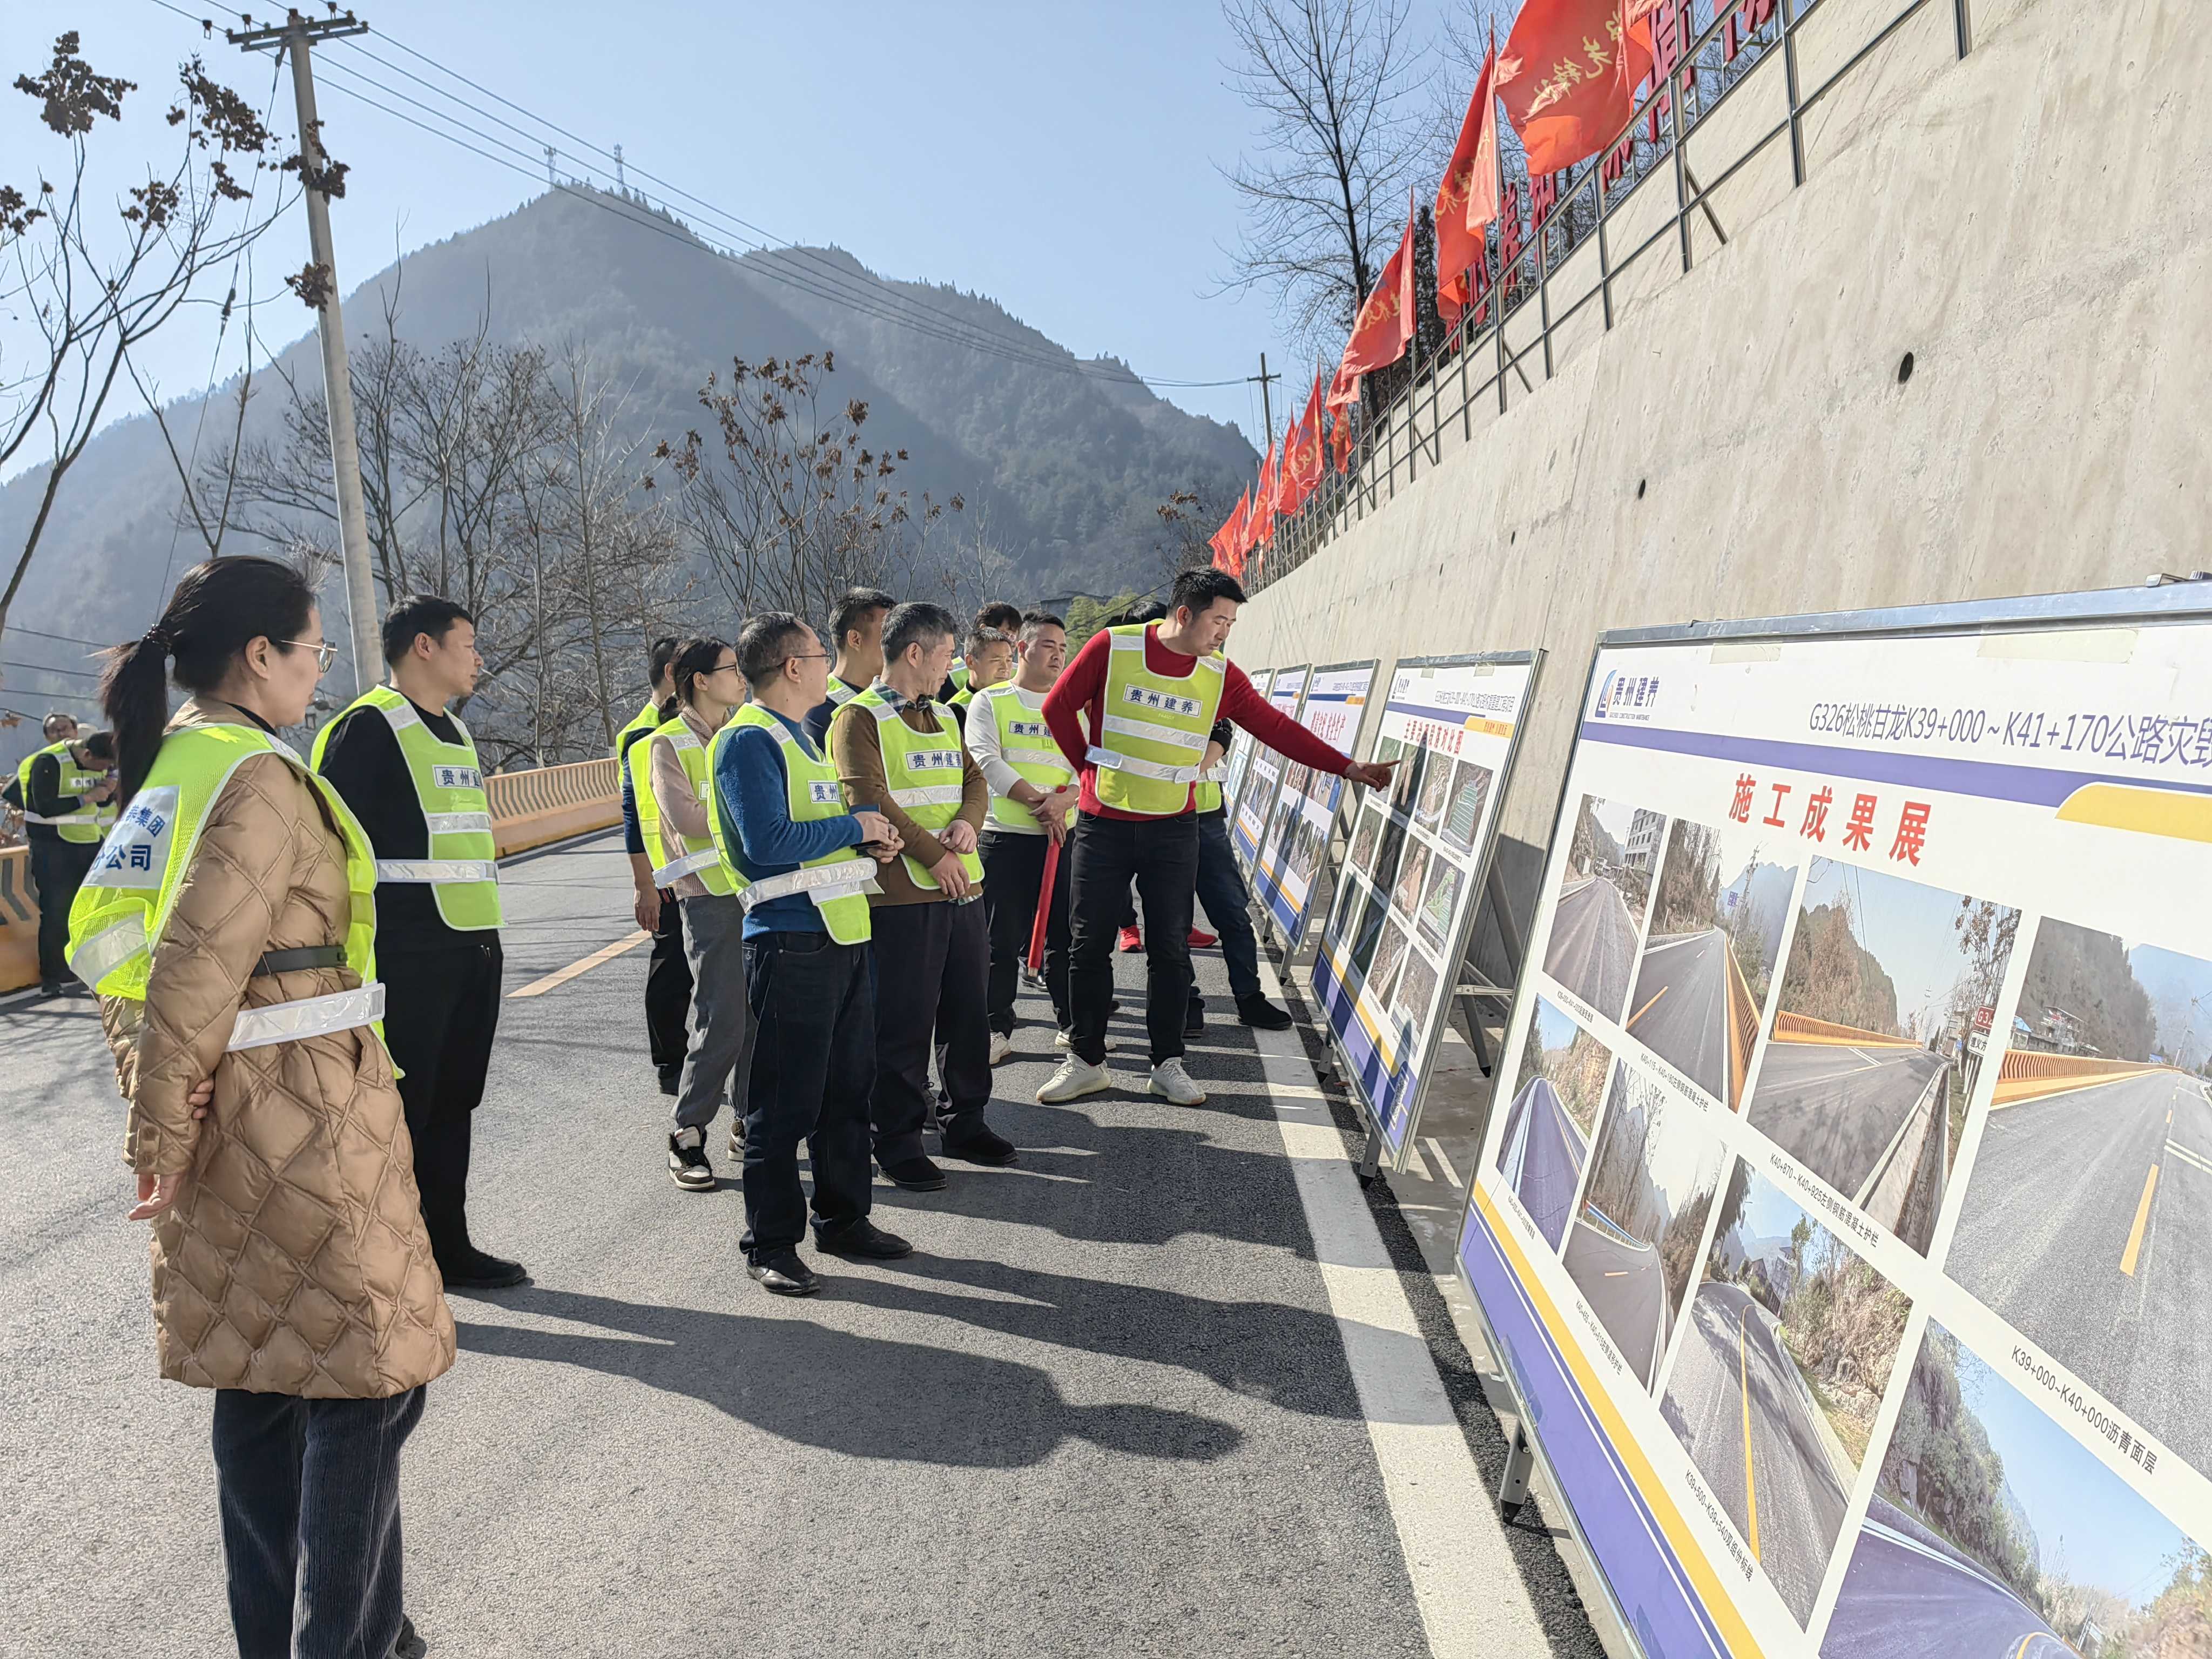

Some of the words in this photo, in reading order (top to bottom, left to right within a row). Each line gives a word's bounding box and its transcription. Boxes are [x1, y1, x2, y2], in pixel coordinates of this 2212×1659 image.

[1130, 689, 1193, 713] 贵州建养
[1613, 677, 1659, 707] 贵州建养
[814, 784, 839, 800] 贵州
[1729, 773, 1931, 867] 施工成果展
[2011, 1345, 2157, 1475] K39+000~K40+000沥青面层
